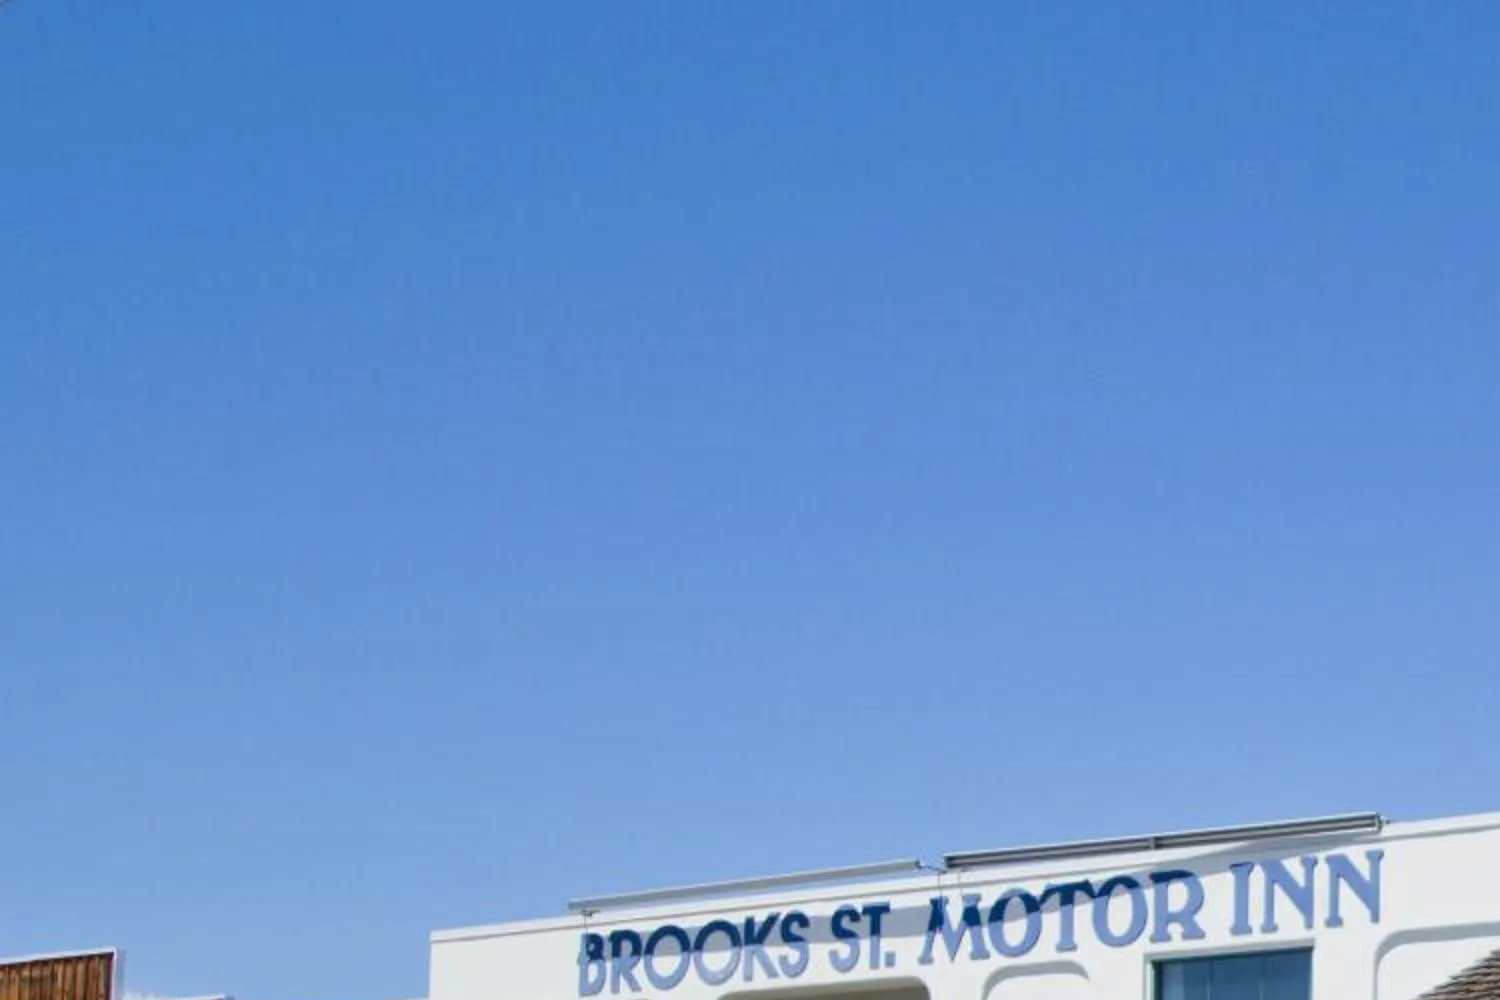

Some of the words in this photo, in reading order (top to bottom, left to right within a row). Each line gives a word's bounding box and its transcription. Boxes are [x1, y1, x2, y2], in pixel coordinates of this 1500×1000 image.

[577, 912, 811, 998] BROOKS
[830, 901, 896, 972] ST.
[918, 870, 1205, 956] MOTOR
[1230, 849, 1385, 935] INN
